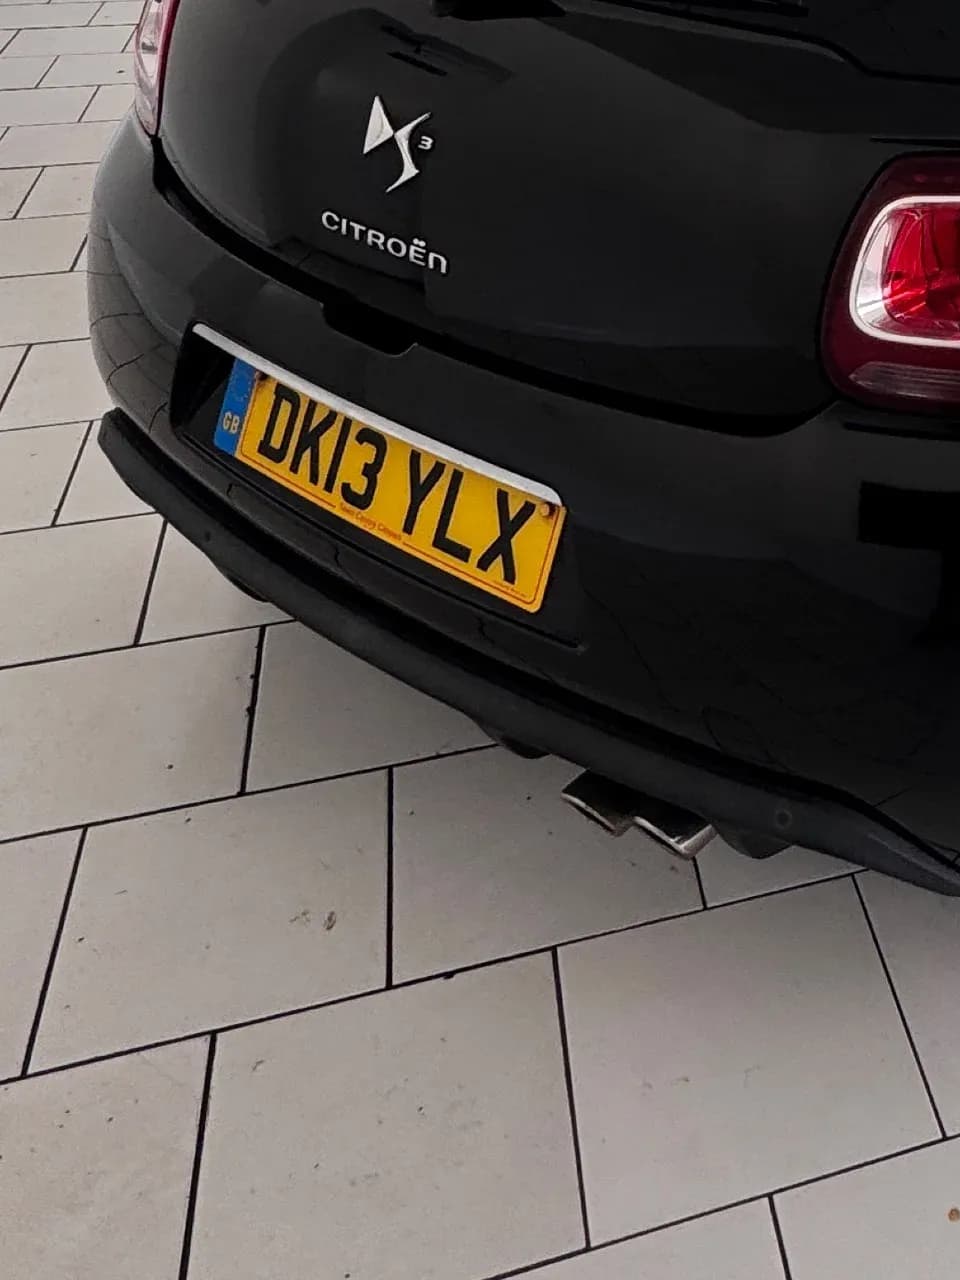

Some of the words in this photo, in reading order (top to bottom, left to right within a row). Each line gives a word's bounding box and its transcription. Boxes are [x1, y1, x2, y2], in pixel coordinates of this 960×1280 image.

[222, 411, 239, 433] GB
[257, 383, 389, 510] DK13
[402, 449, 536, 585] YLX
